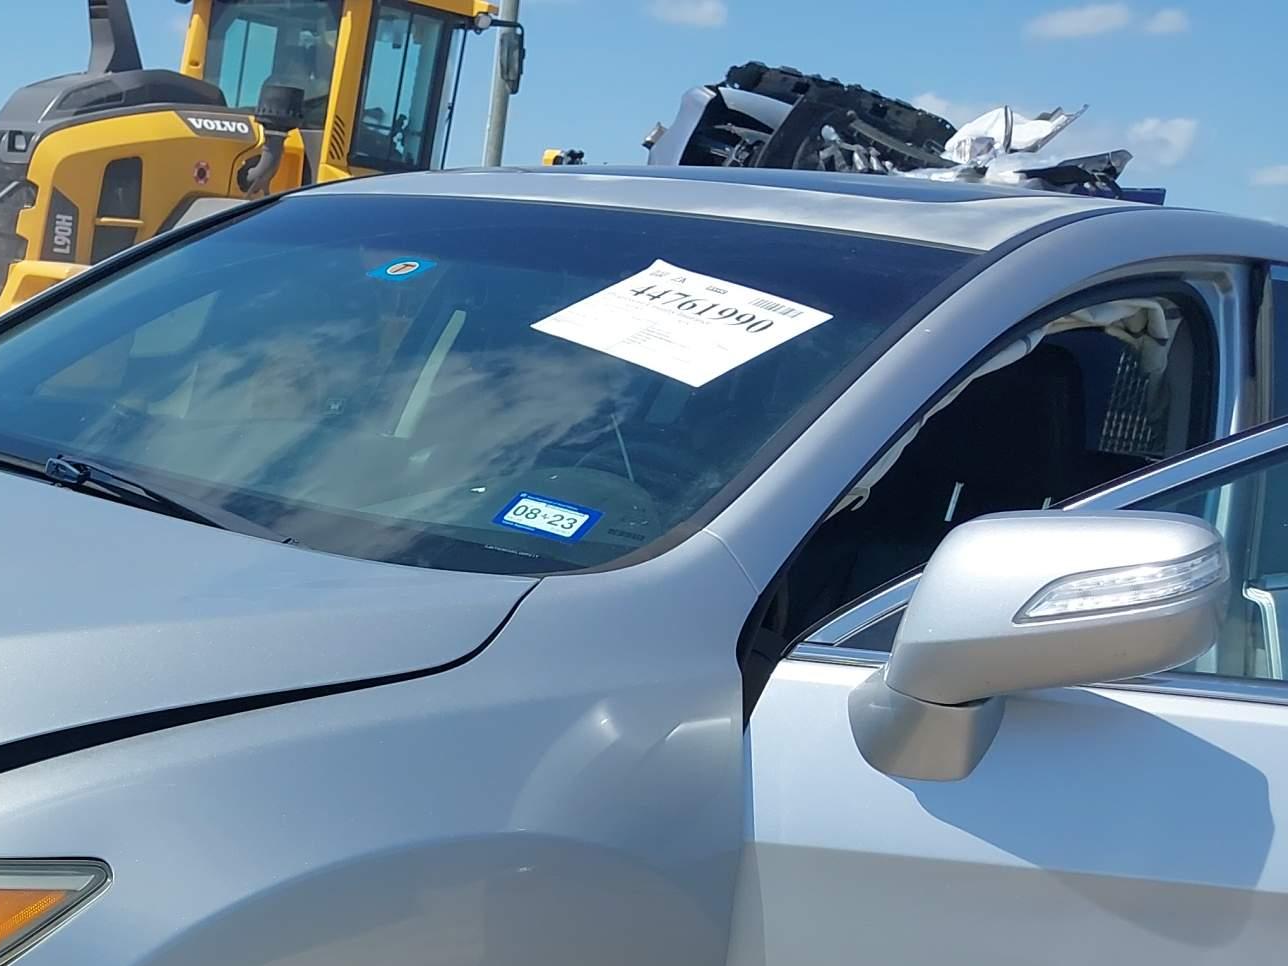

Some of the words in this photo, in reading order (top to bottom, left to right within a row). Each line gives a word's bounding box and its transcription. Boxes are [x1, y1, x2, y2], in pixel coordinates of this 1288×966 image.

[187, 117, 249, 134] VOLVO
[53, 213, 73, 254] L90H
[630, 284, 775, 334] 44761990
[512, 504, 542, 520] 08
[546, 513, 578, 530] 23
